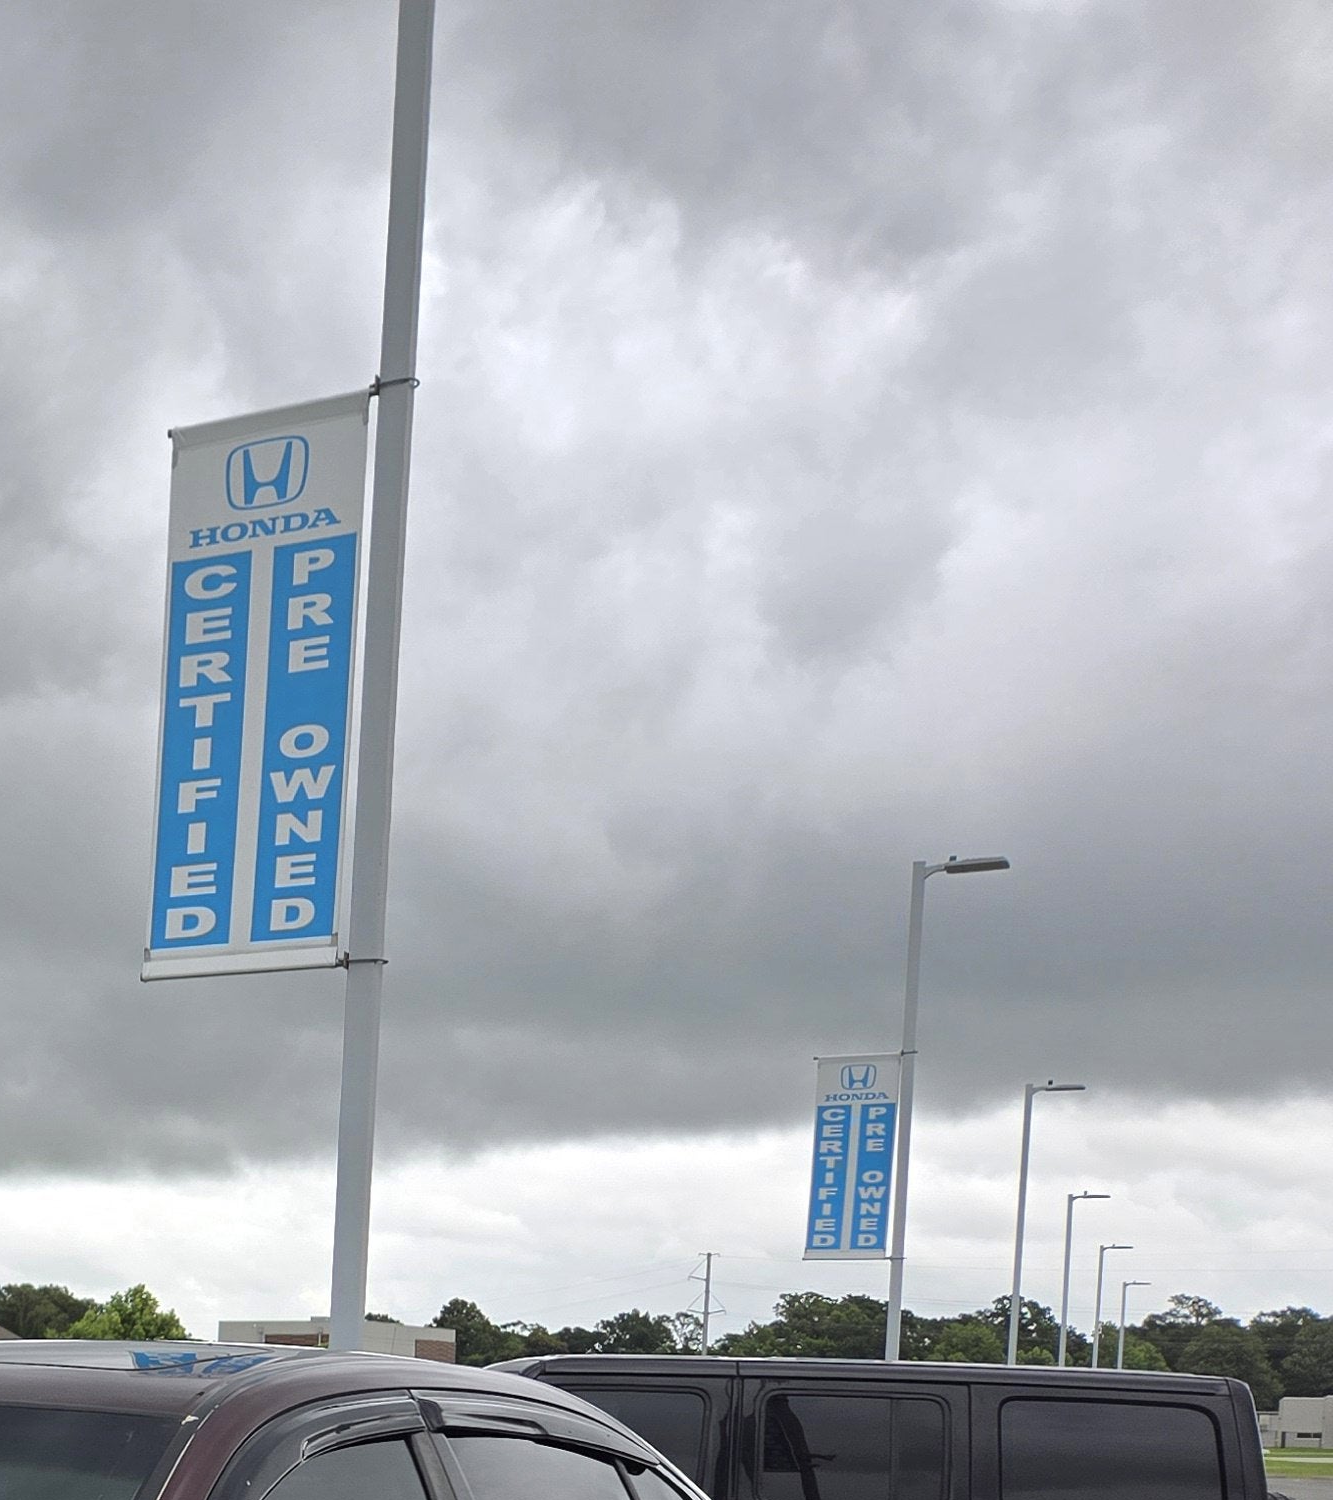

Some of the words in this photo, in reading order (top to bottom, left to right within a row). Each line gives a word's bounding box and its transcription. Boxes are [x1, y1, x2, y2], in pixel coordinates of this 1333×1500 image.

[188, 507, 341, 549] HONDA
[286, 547, 335, 674] PRE
[164, 563, 238, 941] CERTIFIED
[269, 723, 336, 932] OWNED
[825, 1092, 889, 1102] HONDA
[866, 1107, 886, 1152] PRE
[812, 1108, 846, 1247] CERTIFIED
[857, 1170, 886, 1246] OWNED
